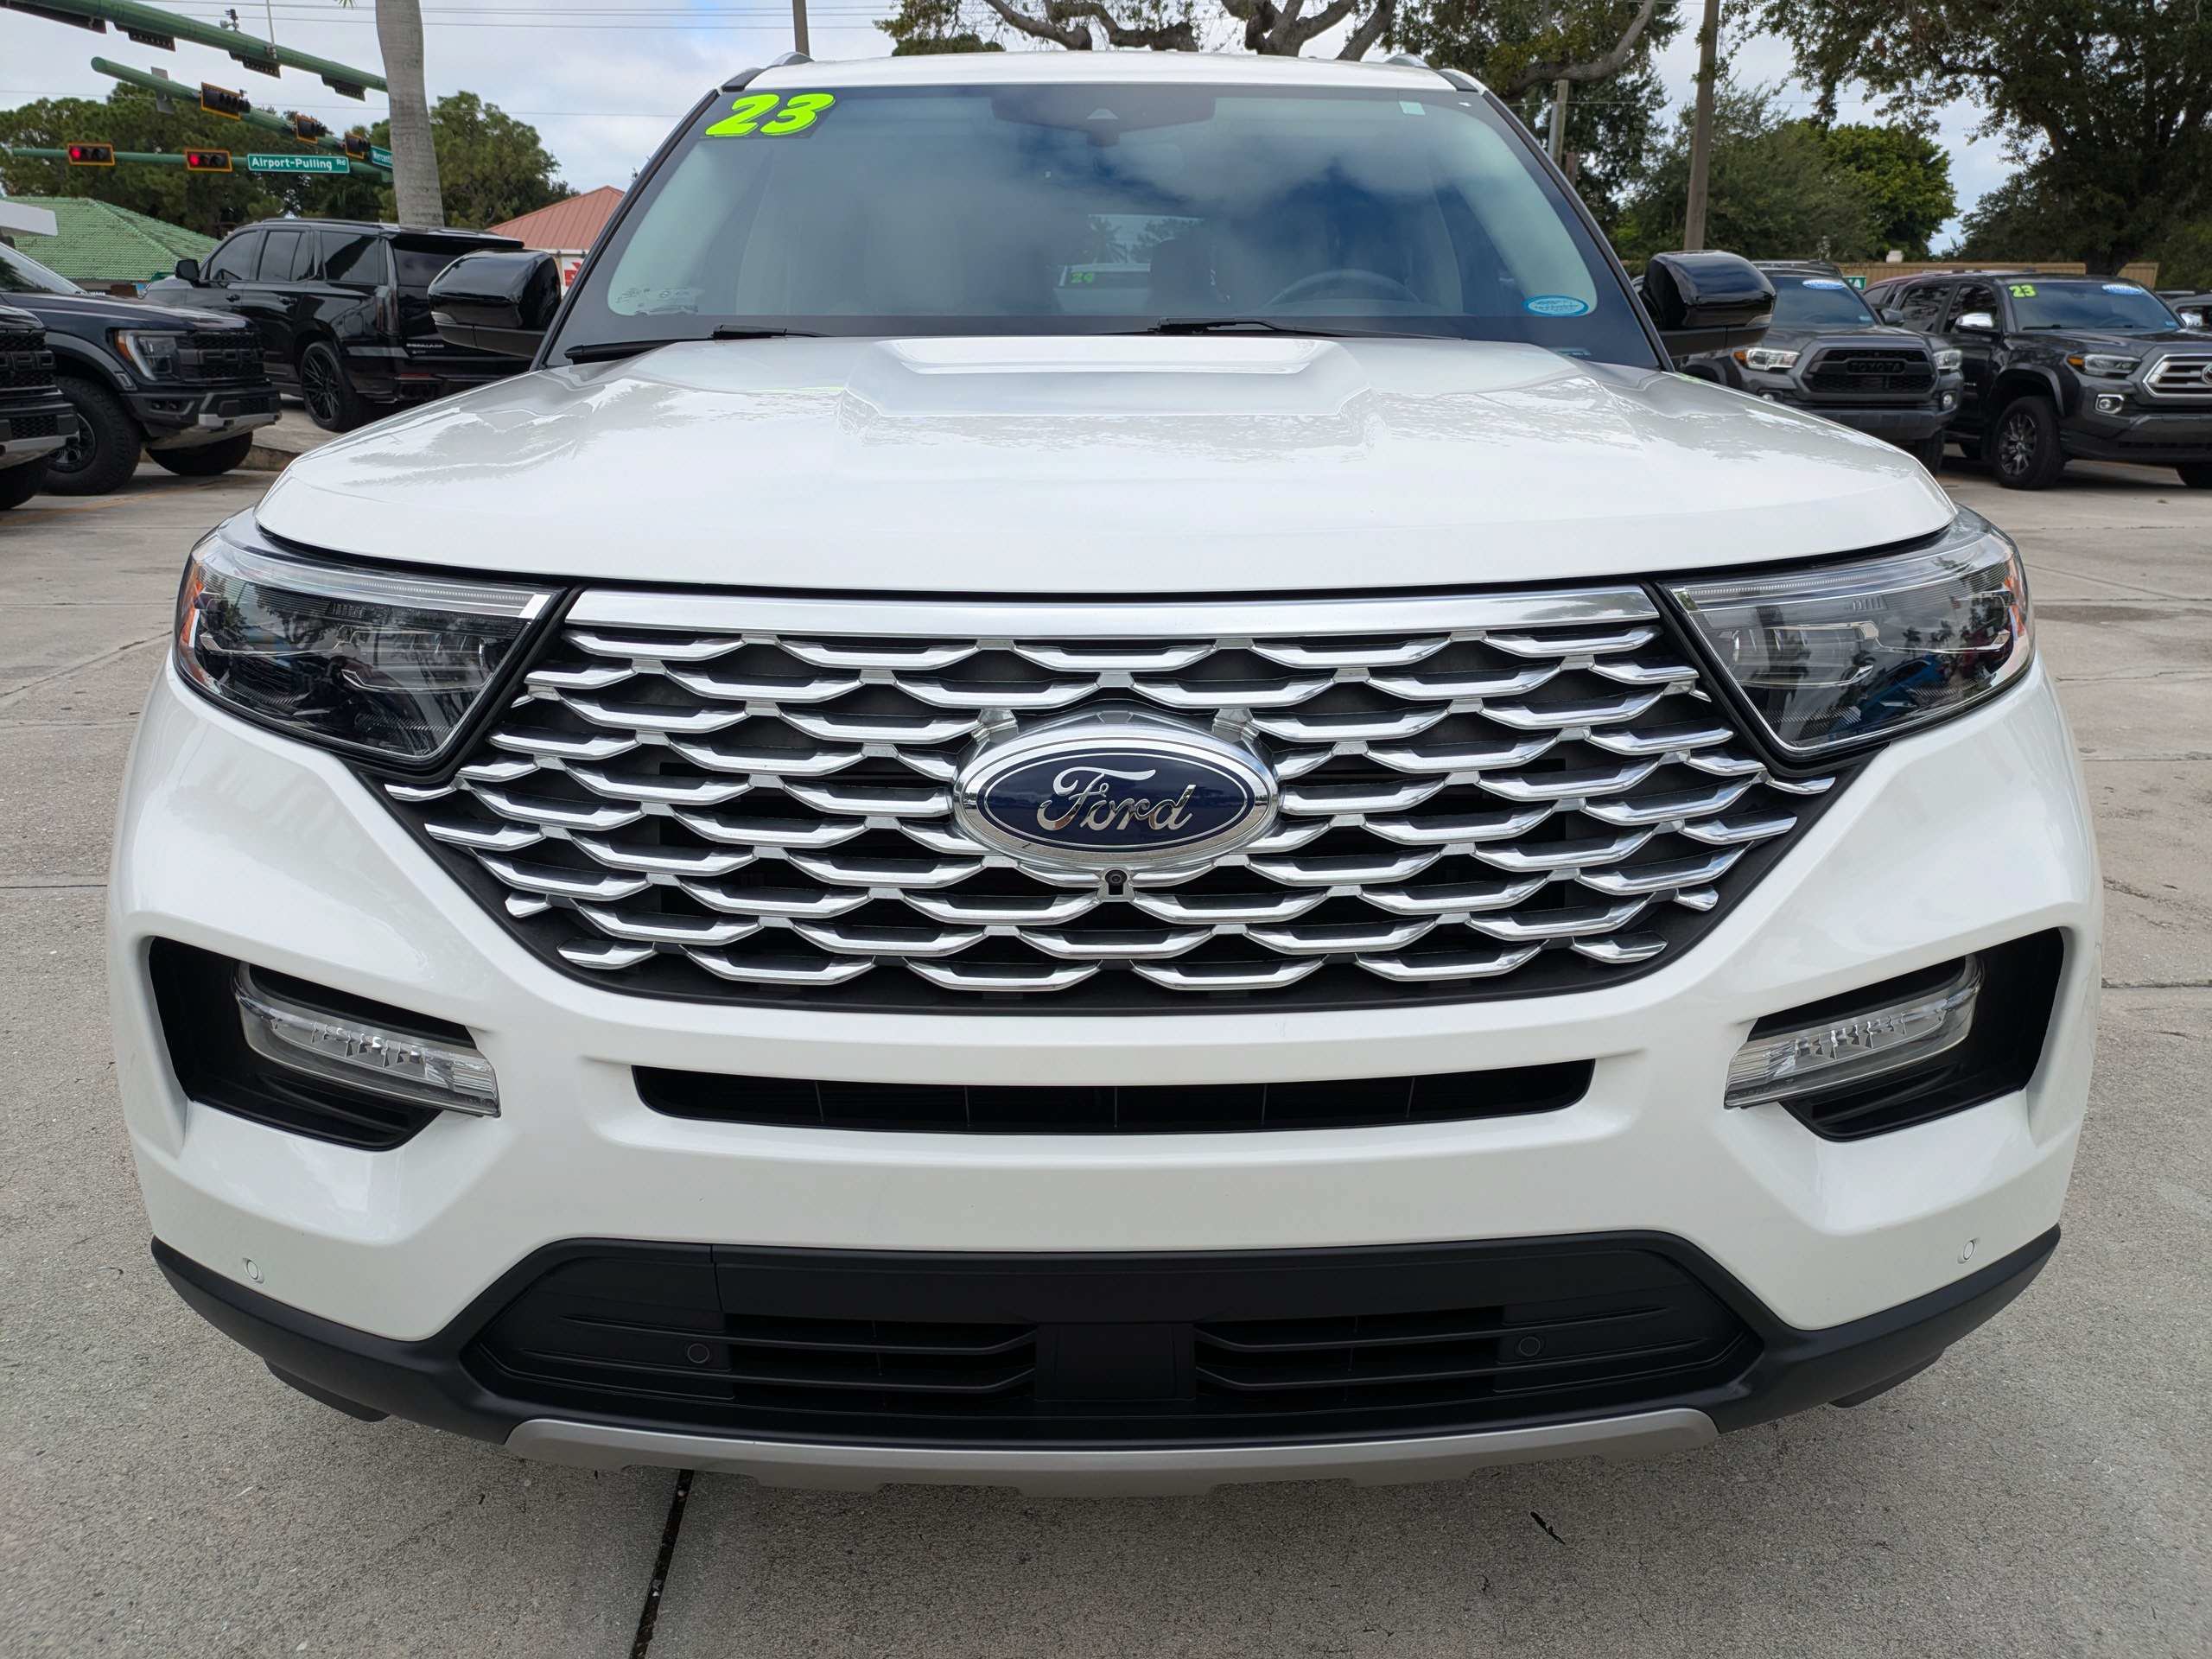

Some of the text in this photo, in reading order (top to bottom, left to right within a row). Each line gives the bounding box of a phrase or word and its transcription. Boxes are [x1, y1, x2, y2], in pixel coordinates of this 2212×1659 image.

[705, 93, 836, 136] 23
[251, 157, 333, 171] Airport-Pulling
[2008, 284, 2037, 298] 23
[1851, 361, 1901, 372] TOYOTA
[1036, 766, 1197, 831] Ford
